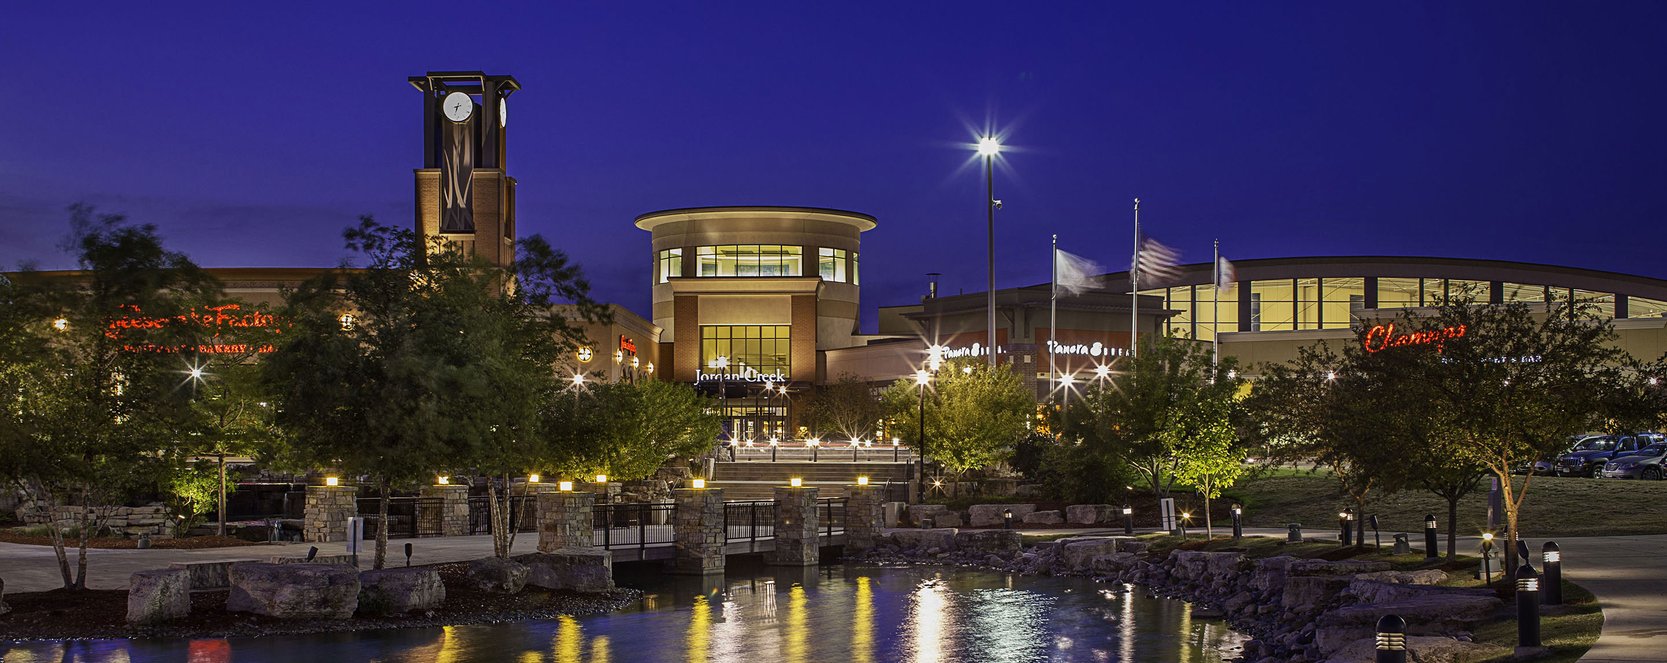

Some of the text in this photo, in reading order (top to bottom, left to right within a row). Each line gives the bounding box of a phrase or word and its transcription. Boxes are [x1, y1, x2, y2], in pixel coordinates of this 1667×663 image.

[1047, 340, 1089, 356] Panera
[694, 367, 786, 386] Jordan Creek
